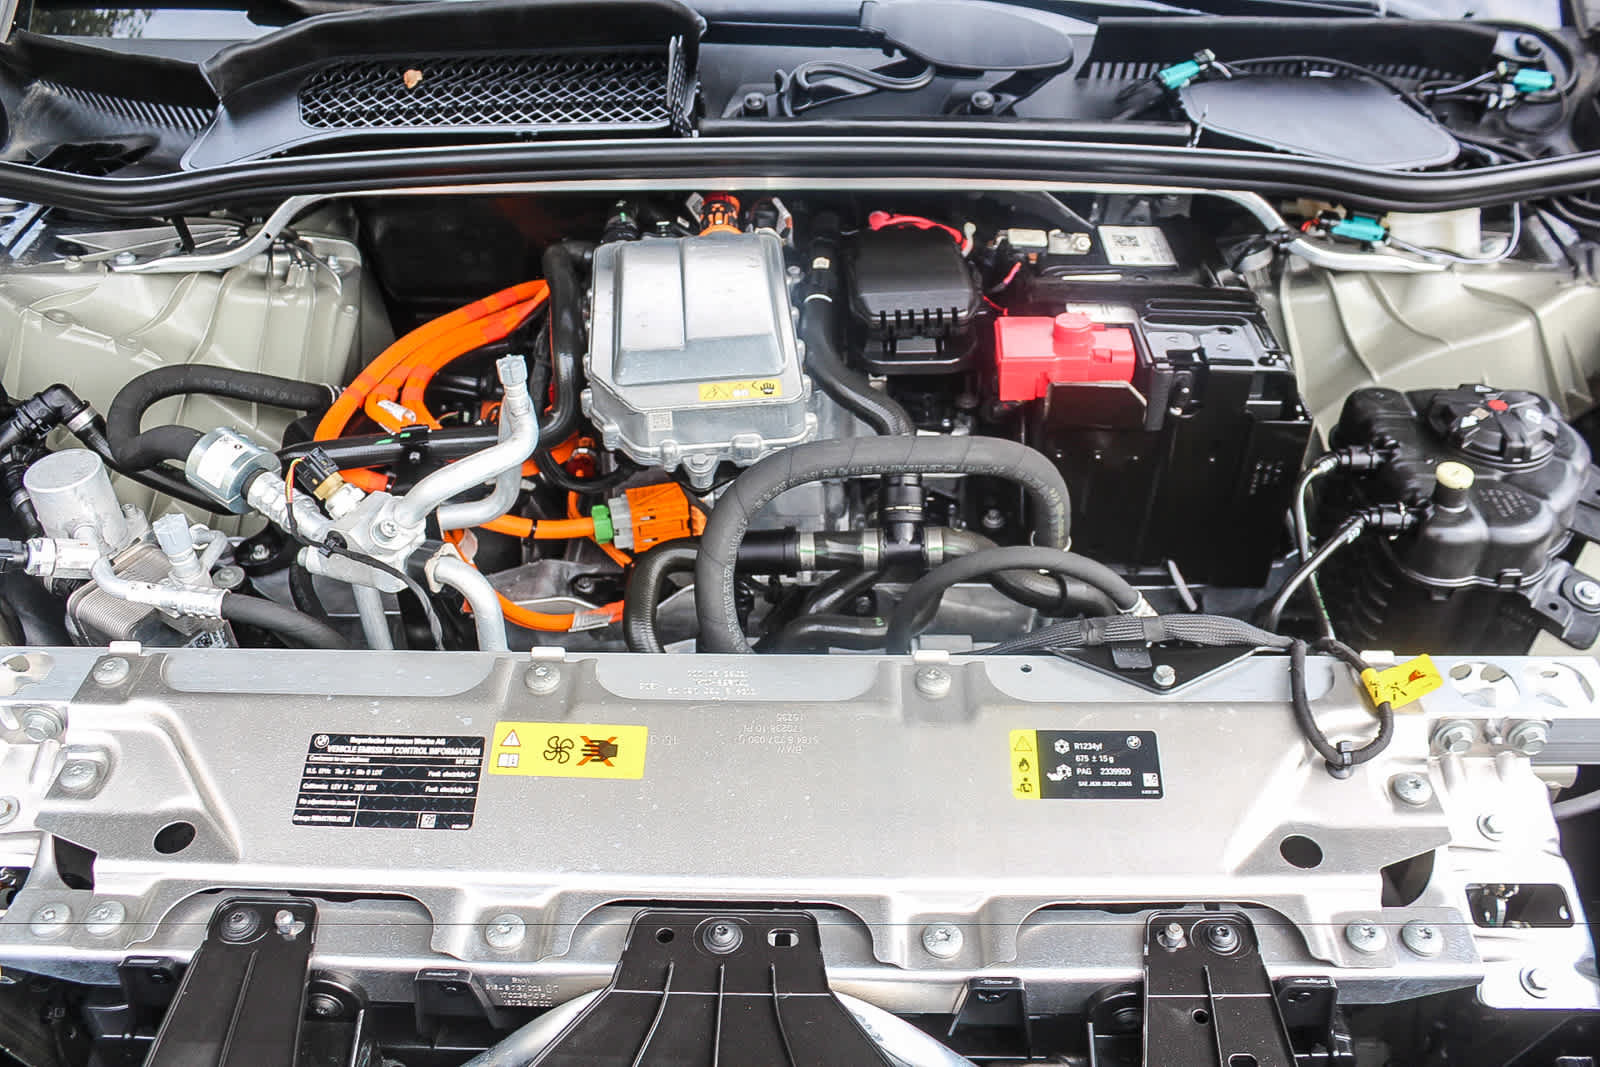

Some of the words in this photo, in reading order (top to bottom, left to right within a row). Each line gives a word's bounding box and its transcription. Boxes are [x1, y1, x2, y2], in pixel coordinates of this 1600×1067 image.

[349, 736, 385, 745] Bayerische
[385, 737, 413, 745] Motoren
[413, 738, 435, 746] Werke
[435, 738, 447, 746] AG
[327, 744, 358, 754] VEHICLE
[358, 746, 393, 755] EMISSION
[394, 746, 428, 756] CONTROL
[429, 747, 481, 756] INFORMATION
[1073, 742, 1103, 751] R1234yf
[1076, 767, 1093, 776] PAG
